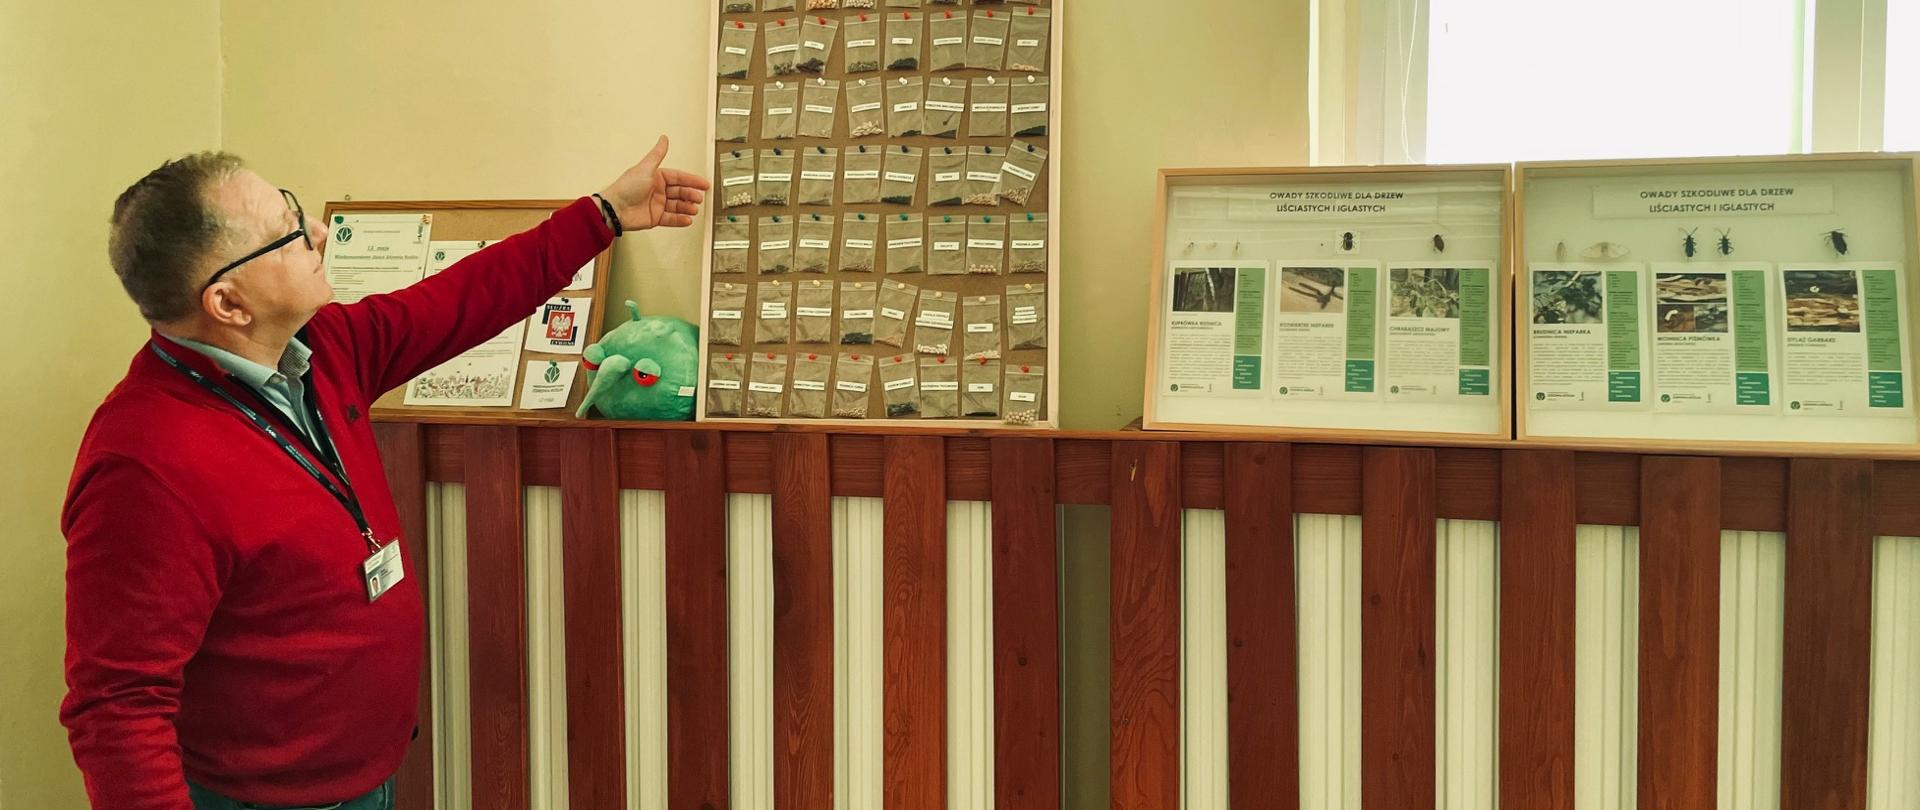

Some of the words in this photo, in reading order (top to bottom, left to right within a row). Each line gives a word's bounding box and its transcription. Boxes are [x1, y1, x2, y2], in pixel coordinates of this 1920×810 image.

[1269, 191, 1303, 200] OWADY
[1305, 191, 1353, 200] SZKODLIWE
[1355, 191, 1372, 200] DLA
[1374, 191, 1404, 200] DRZEW
[1640, 190, 1678, 199] OWADY
[1681, 189, 1735, 198] SZKODLIWE
[1738, 188, 1757, 197] DLA
[1761, 187, 1794, 197] DRZEW
[1276, 203, 1330, 213] LIŚCIASTYCH
[1337, 204, 1386, 213] IGLASTYCH
[1649, 203, 1711, 213] LIŚCIASTYCH
[1719, 202, 1775, 212] IGLASTYCH
